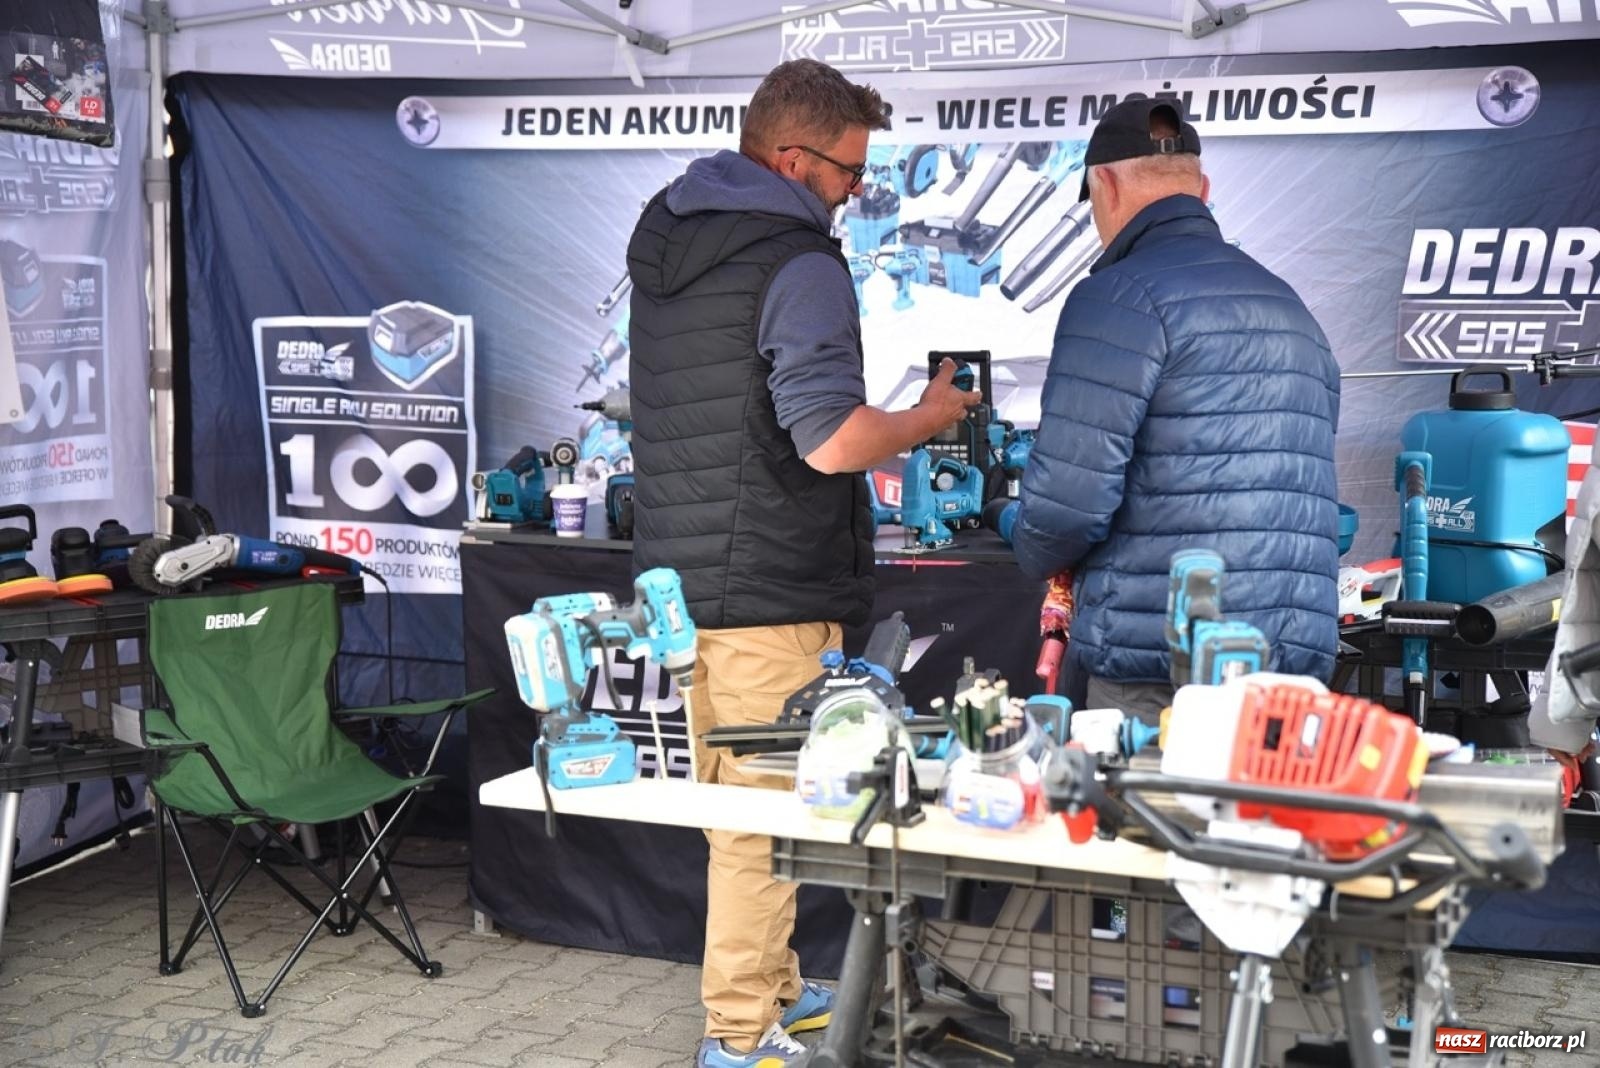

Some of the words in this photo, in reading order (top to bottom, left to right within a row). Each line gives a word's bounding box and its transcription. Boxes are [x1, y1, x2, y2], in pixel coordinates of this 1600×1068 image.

[502, 106, 612, 136] JEDEN
[937, 96, 1068, 130] WIELE
[1078, 75, 1376, 126] MLIWOŚCI
[1402, 227, 1600, 294] DEDR
[1456, 321, 1547, 354] SAS
[271, 396, 336, 415] SINGLE
[369, 402, 459, 424] SOLUTION
[320, 526, 373, 555] 150
[418, 564, 461, 583] WIĘCE
[205, 612, 247, 630] DEDRA
